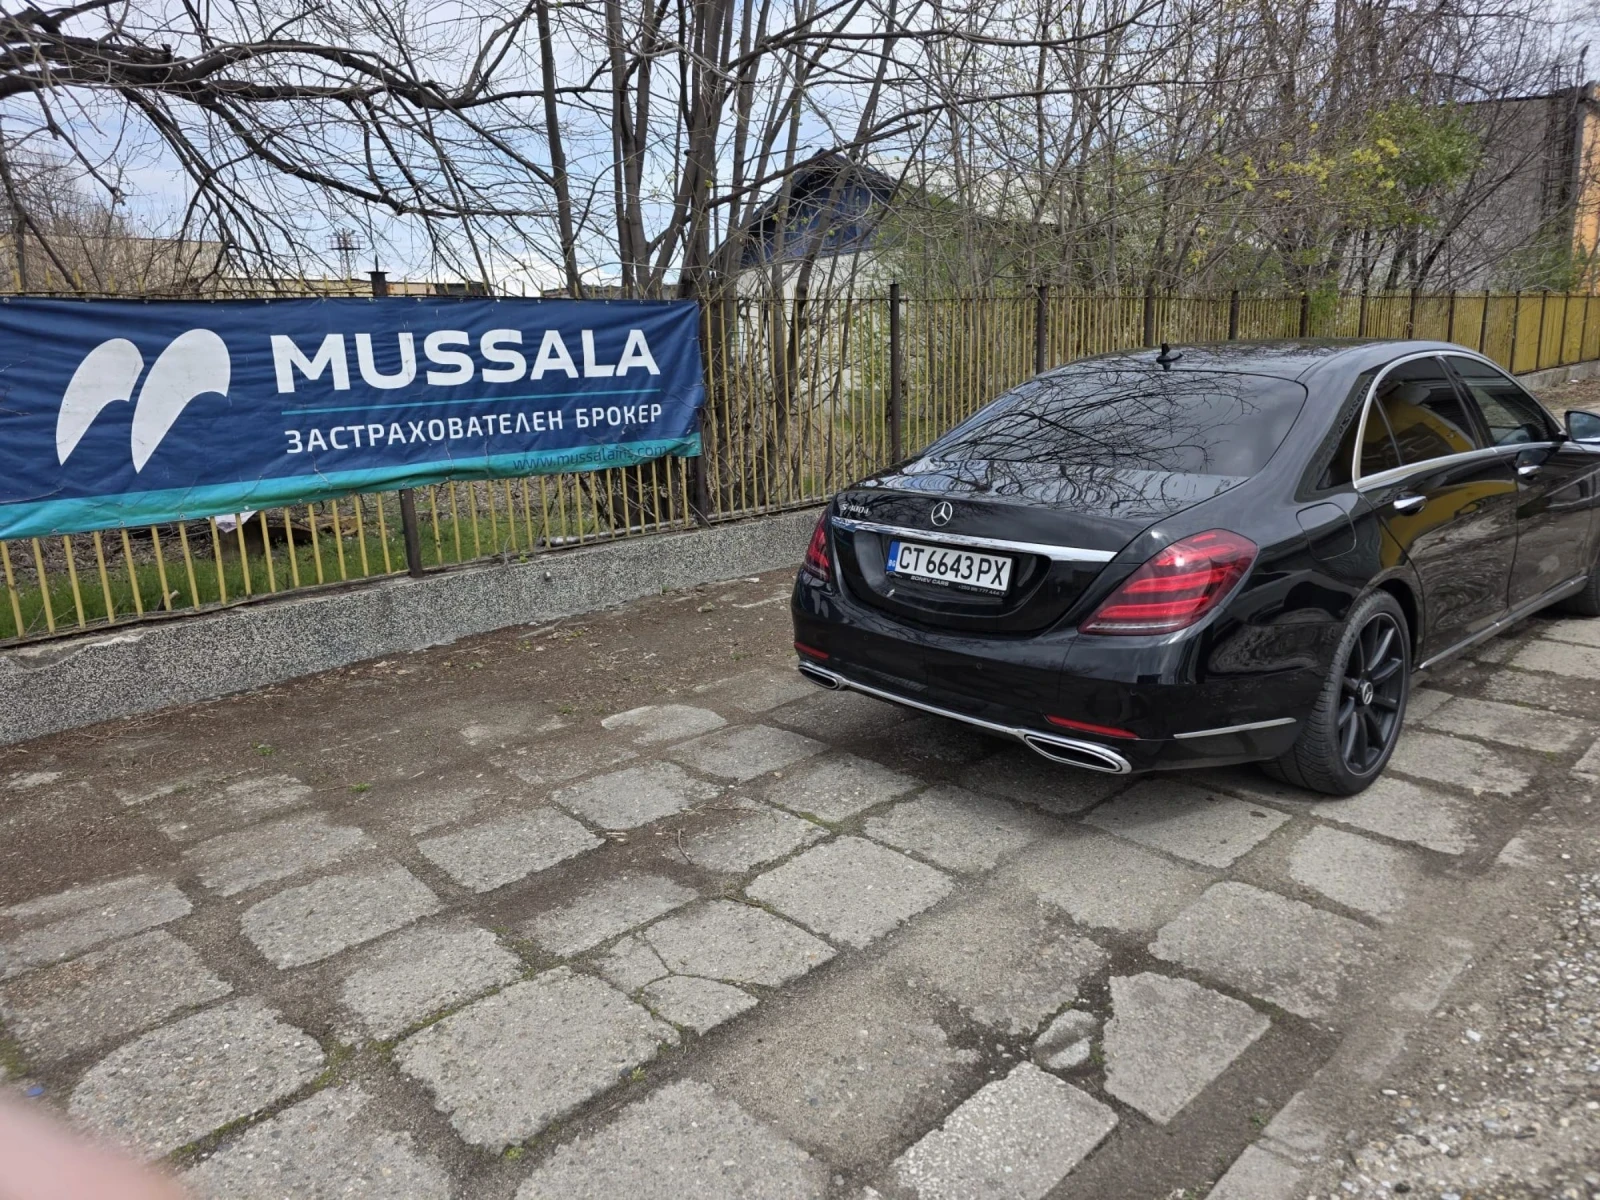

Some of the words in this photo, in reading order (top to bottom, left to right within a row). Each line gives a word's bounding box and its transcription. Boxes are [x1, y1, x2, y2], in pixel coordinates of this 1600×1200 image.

[269, 328, 661, 394] MUSSALA
[284, 410, 564, 454] ЗАСТРАХОВАТЕЛЕН
[575, 403, 662, 429] БРОКЕР
[512, 444, 668, 470] www.mussalains.com
[899, 546, 925, 572] CT
[926, 550, 975, 580] 6643
[976, 557, 1007, 587] PX
